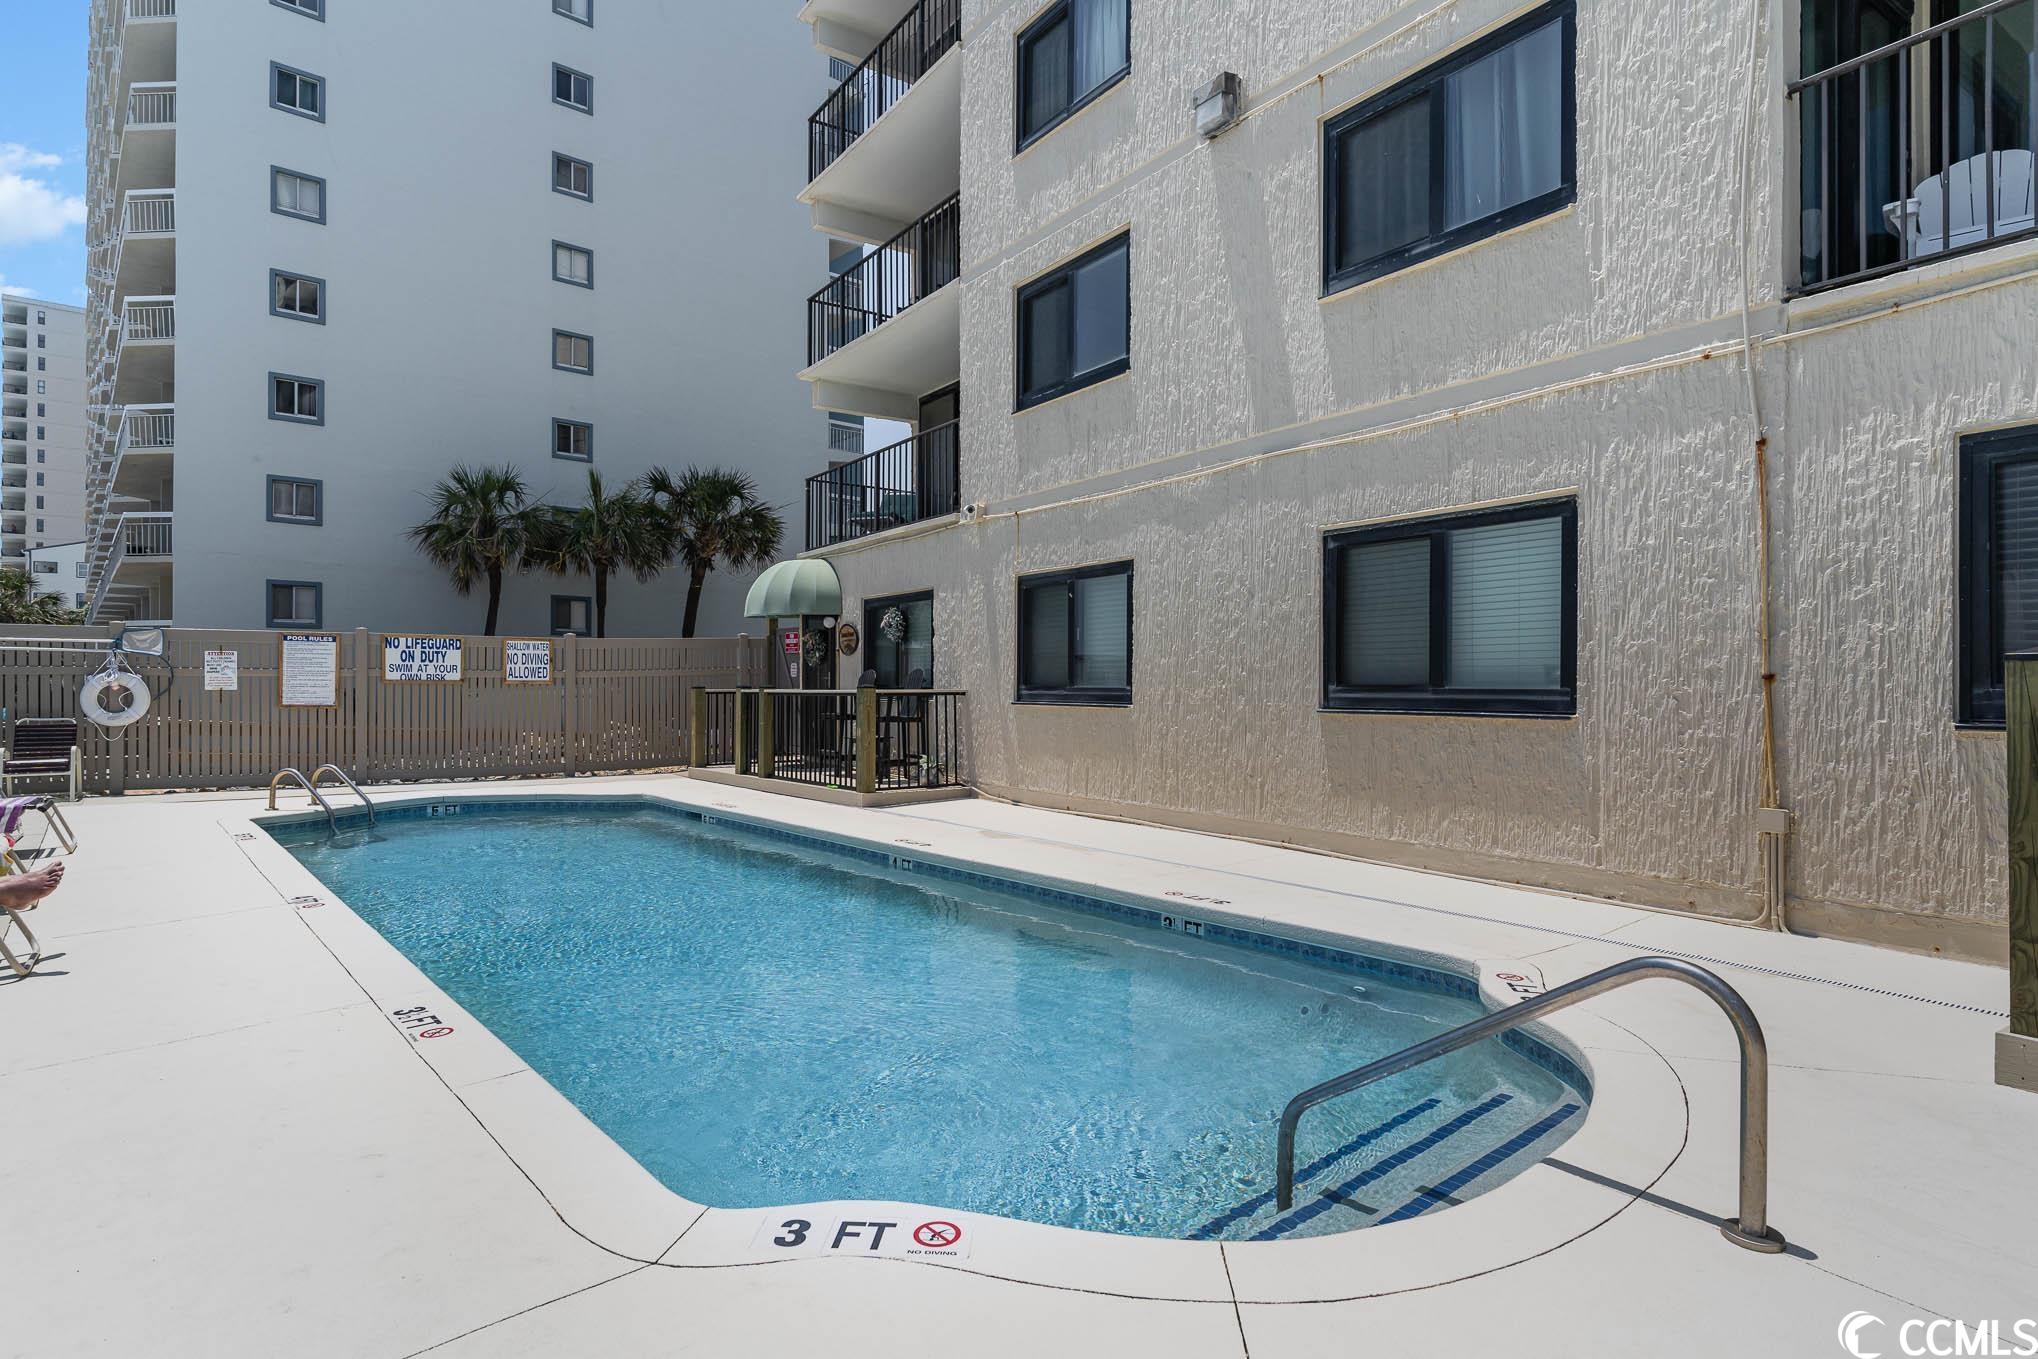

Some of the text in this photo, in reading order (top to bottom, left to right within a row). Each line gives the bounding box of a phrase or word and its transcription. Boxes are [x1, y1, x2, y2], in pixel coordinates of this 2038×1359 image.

[385, 637, 462, 650] NO LIFEGUARD
[507, 642, 531, 651] SHALLOW
[400, 650, 447, 663] ON DUTY
[507, 653, 549, 665] NO DIVING
[388, 663, 458, 673] SWIM AT YOUR
[508, 666, 548, 679] ALLOWED
[773, 1219, 898, 1251] 3 FT
